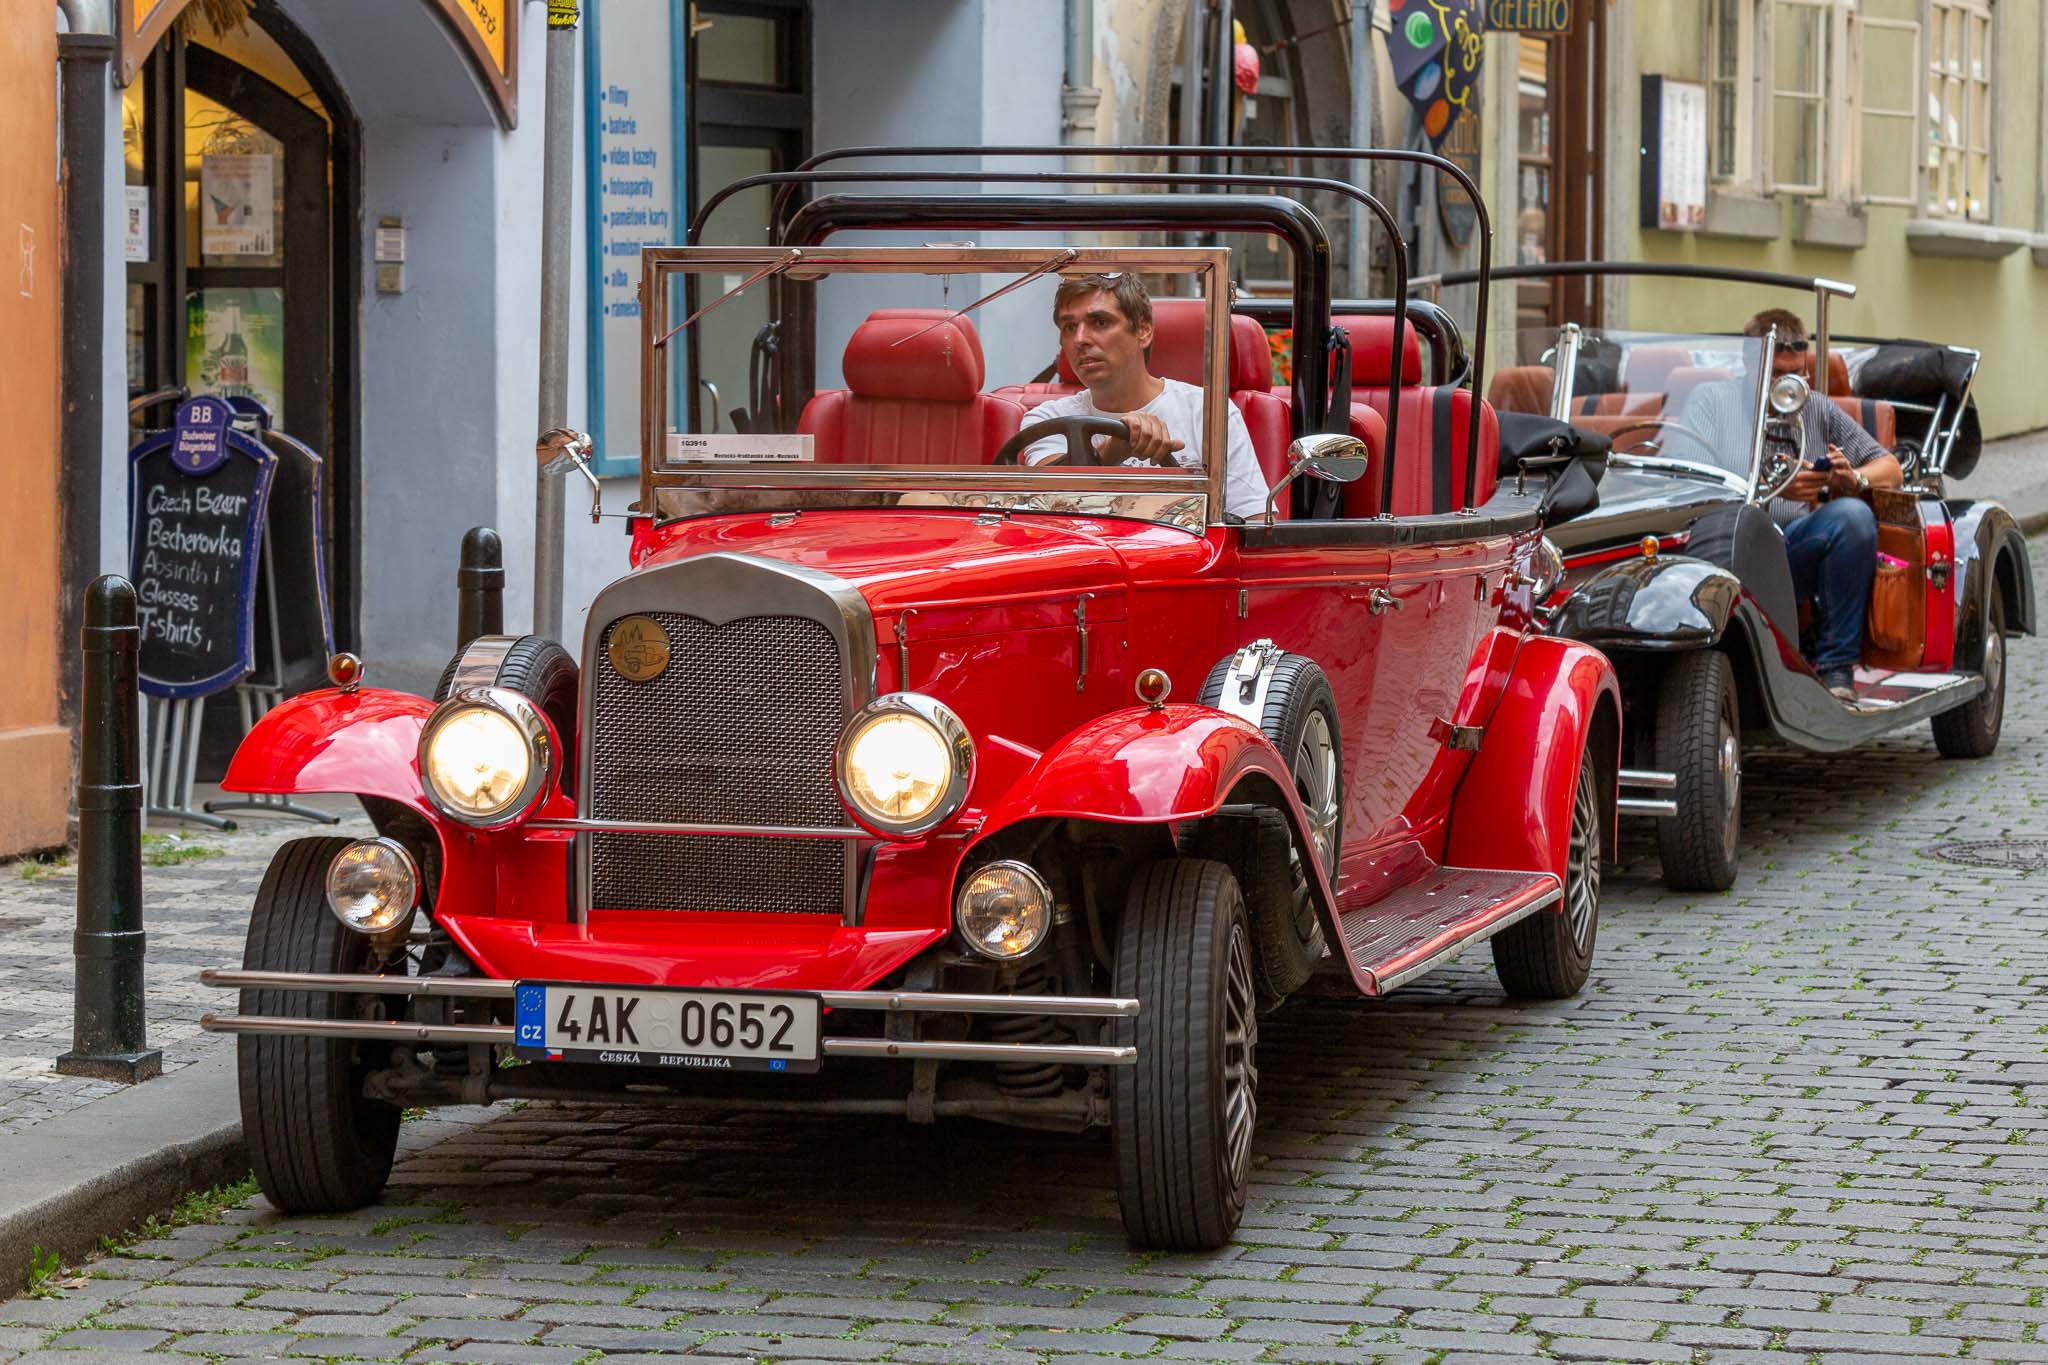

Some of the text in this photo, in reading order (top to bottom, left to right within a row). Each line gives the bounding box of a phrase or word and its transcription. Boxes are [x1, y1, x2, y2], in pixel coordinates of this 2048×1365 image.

[1489, 0, 1569, 30] GELATO
[182, 430, 216, 441] Budweiser
[147, 485, 191, 515] Czech
[147, 519, 240, 557] Becherovka
[139, 578, 198, 612] Glasses
[521, 1024, 541, 1040] CZ
[557, 995, 795, 1051] 4AK 0652
[600, 1050, 731, 1068] ČESKÁ REPUBLIKA
